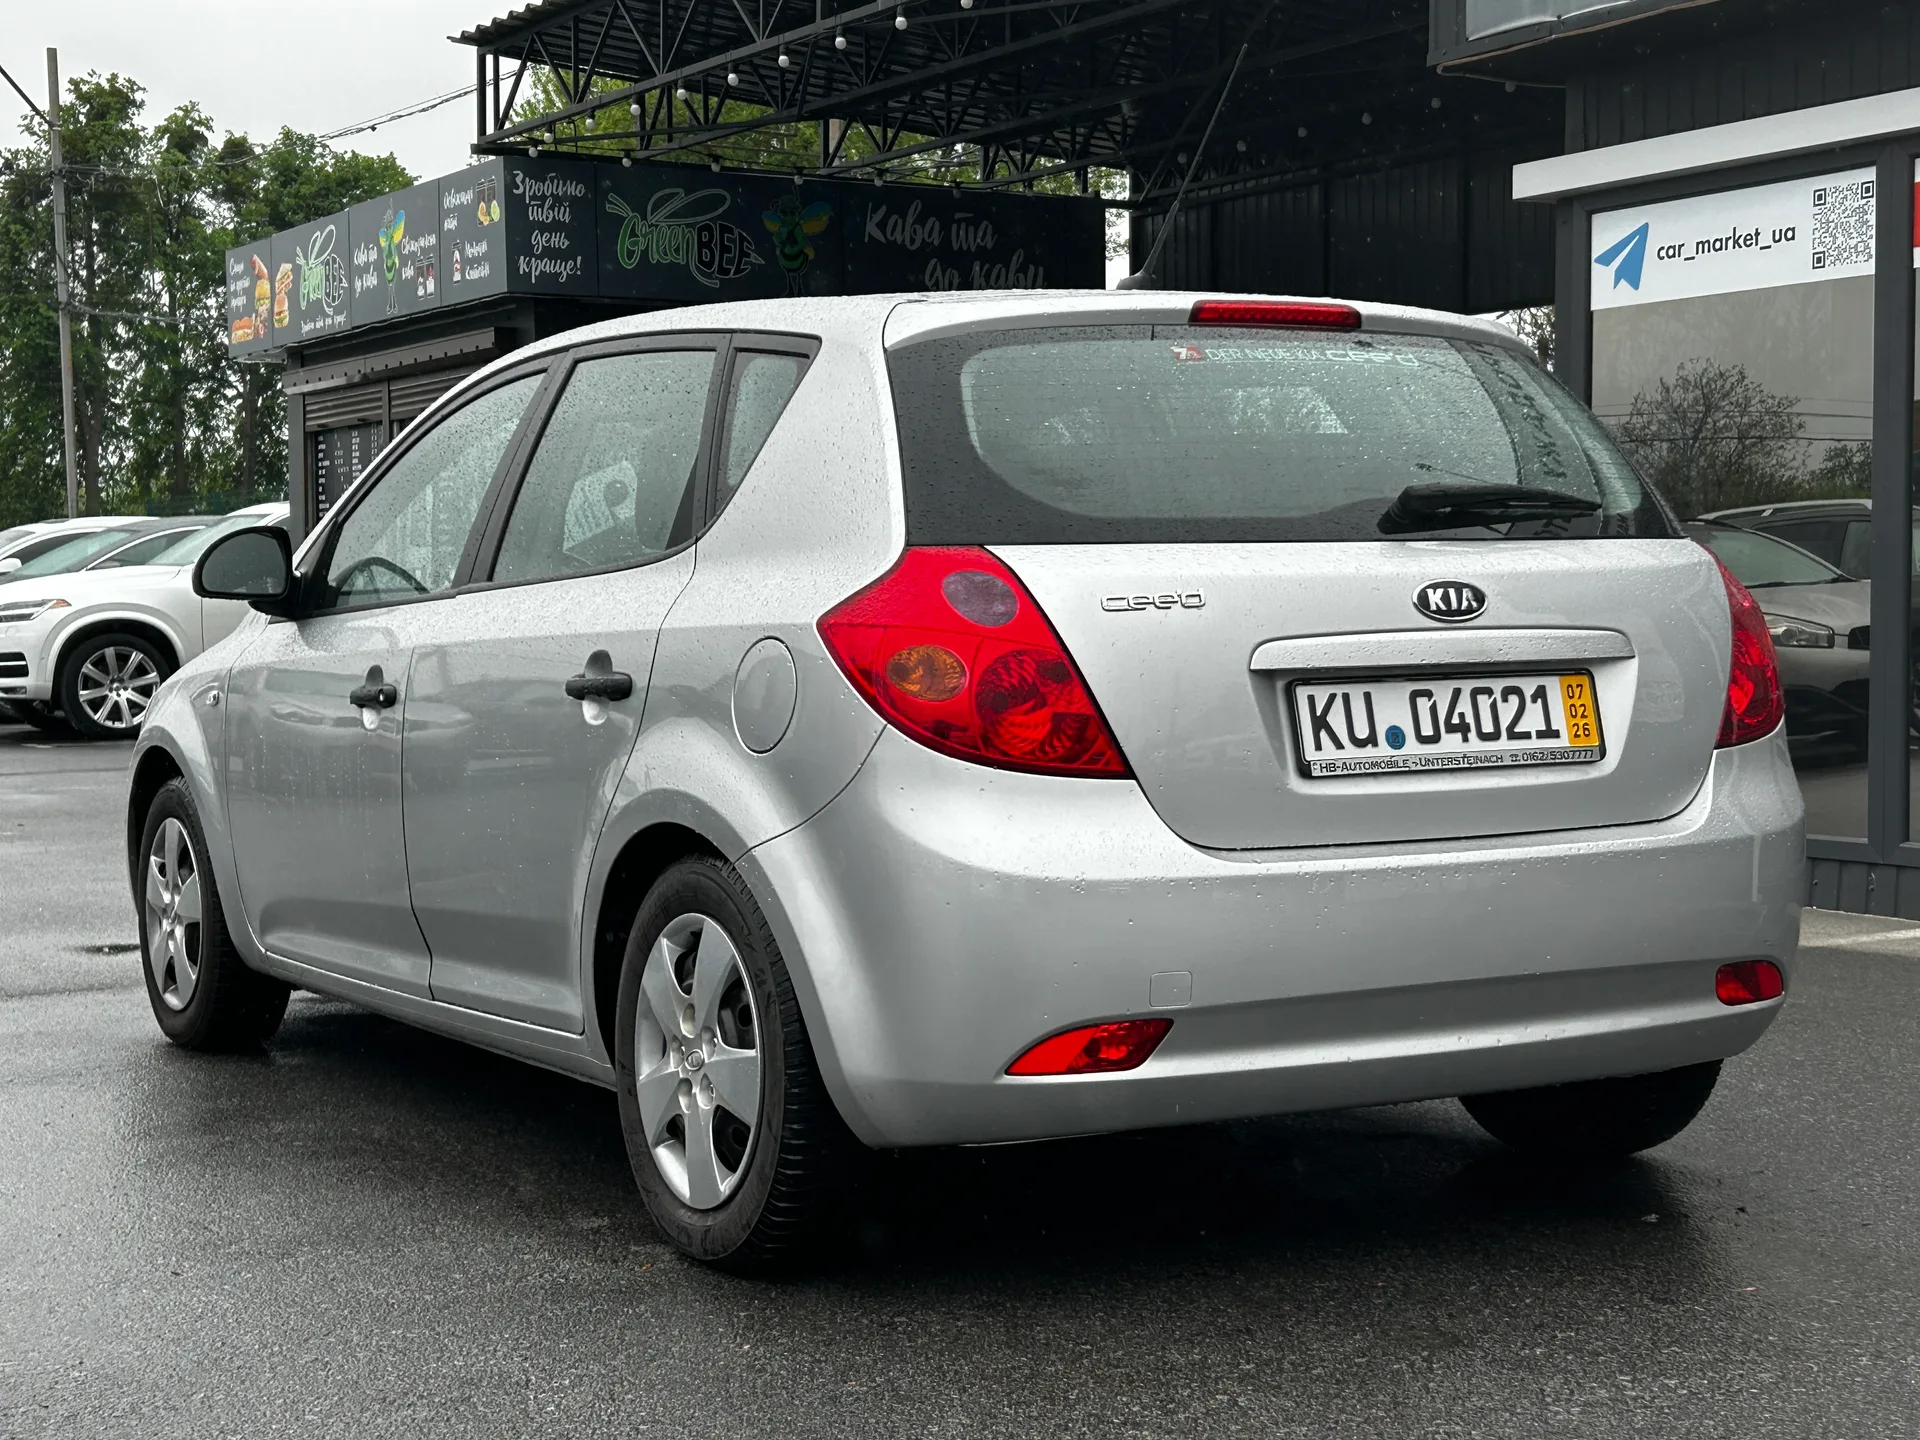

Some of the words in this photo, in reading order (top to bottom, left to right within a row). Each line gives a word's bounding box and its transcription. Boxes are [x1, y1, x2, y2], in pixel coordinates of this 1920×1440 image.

[513, 170, 586, 204] Зробимо
[528, 197, 571, 223] твій
[864, 200, 944, 250] Кава
[950, 212, 998, 252] та
[531, 230, 570, 254] день
[1656, 225, 1797, 261] car_market_ua
[518, 255, 582, 283] краще!
[1426, 588, 1478, 611] KIA
[1566, 683, 1583, 700] 07
[1306, 691, 1379, 752] KU
[1409, 684, 1561, 745] 04021
[1569, 703, 1588, 719] 02
[1572, 722, 1591, 739] 26
[1320, 759, 1411, 774] HB-AUTOMOBILE
